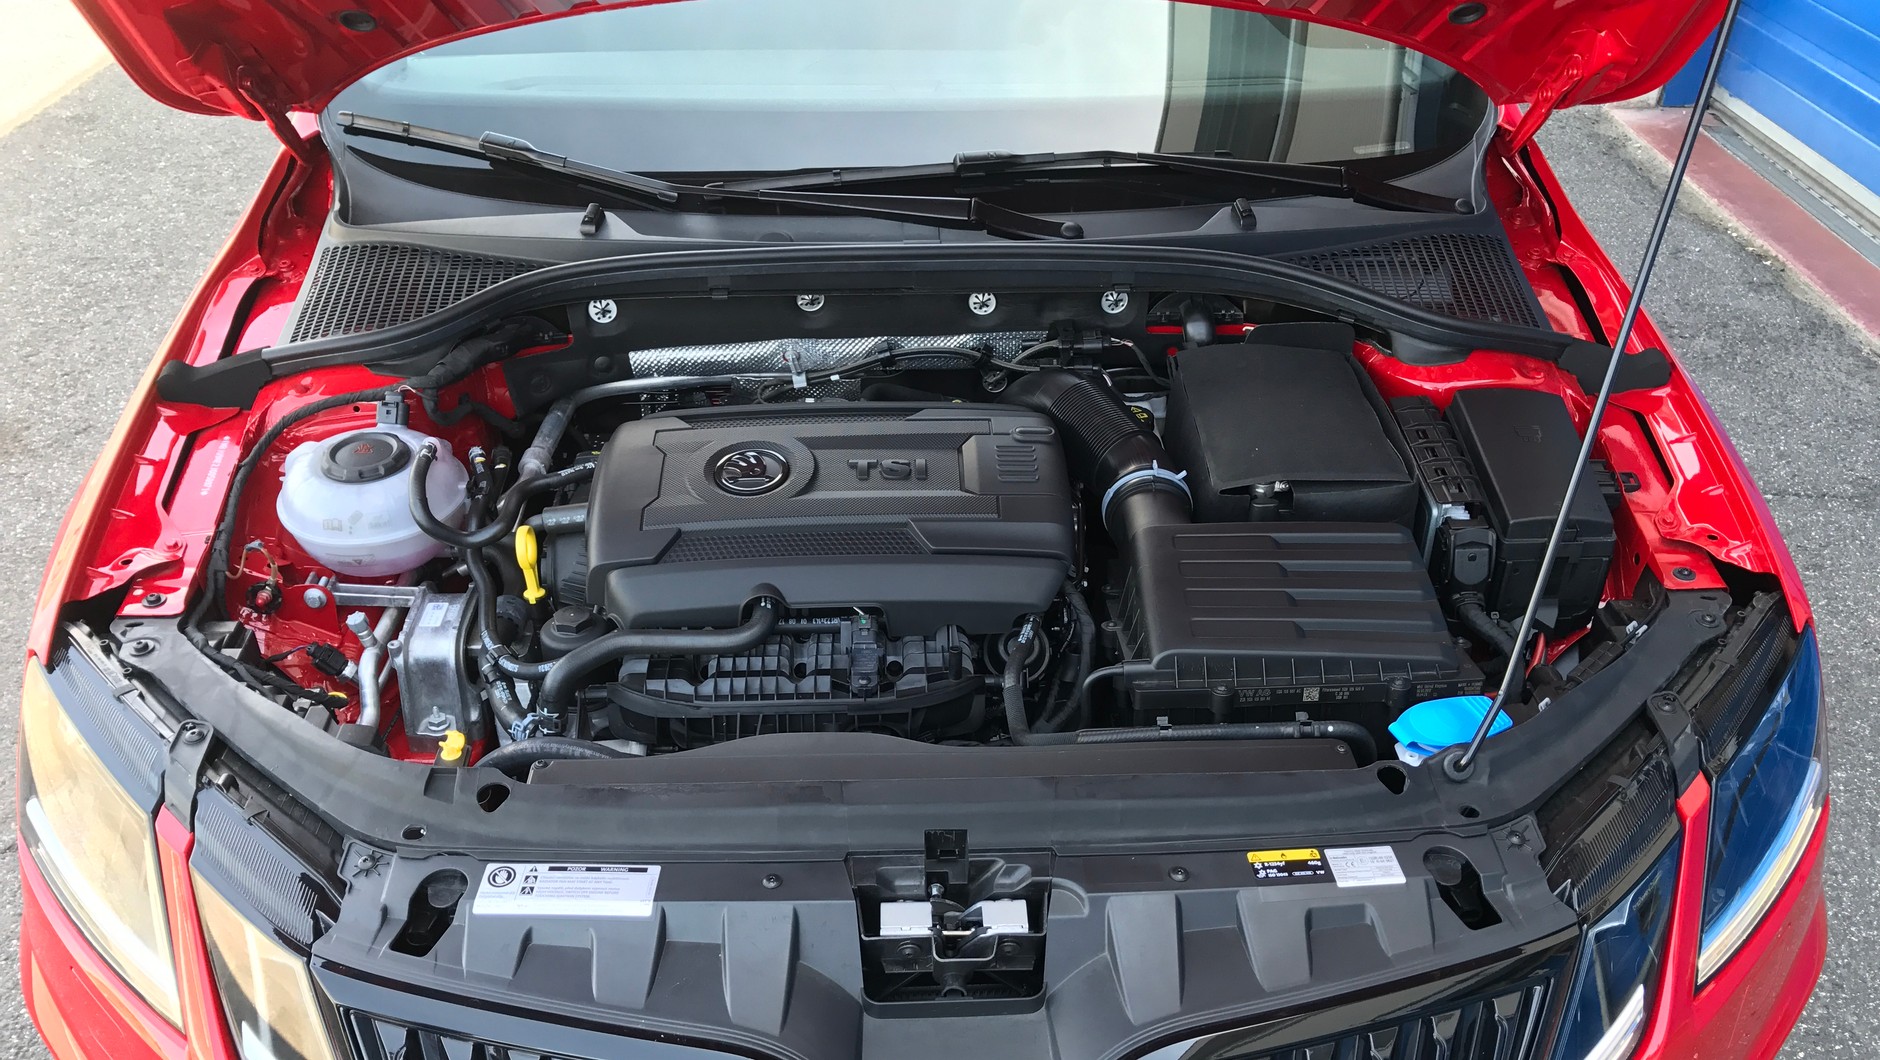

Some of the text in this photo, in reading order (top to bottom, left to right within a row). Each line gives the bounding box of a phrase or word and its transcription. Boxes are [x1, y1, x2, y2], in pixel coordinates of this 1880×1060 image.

[849, 458, 928, 481] TSI
[1238, 689, 1254, 697] VW
[1255, 688, 1271, 696] AG
